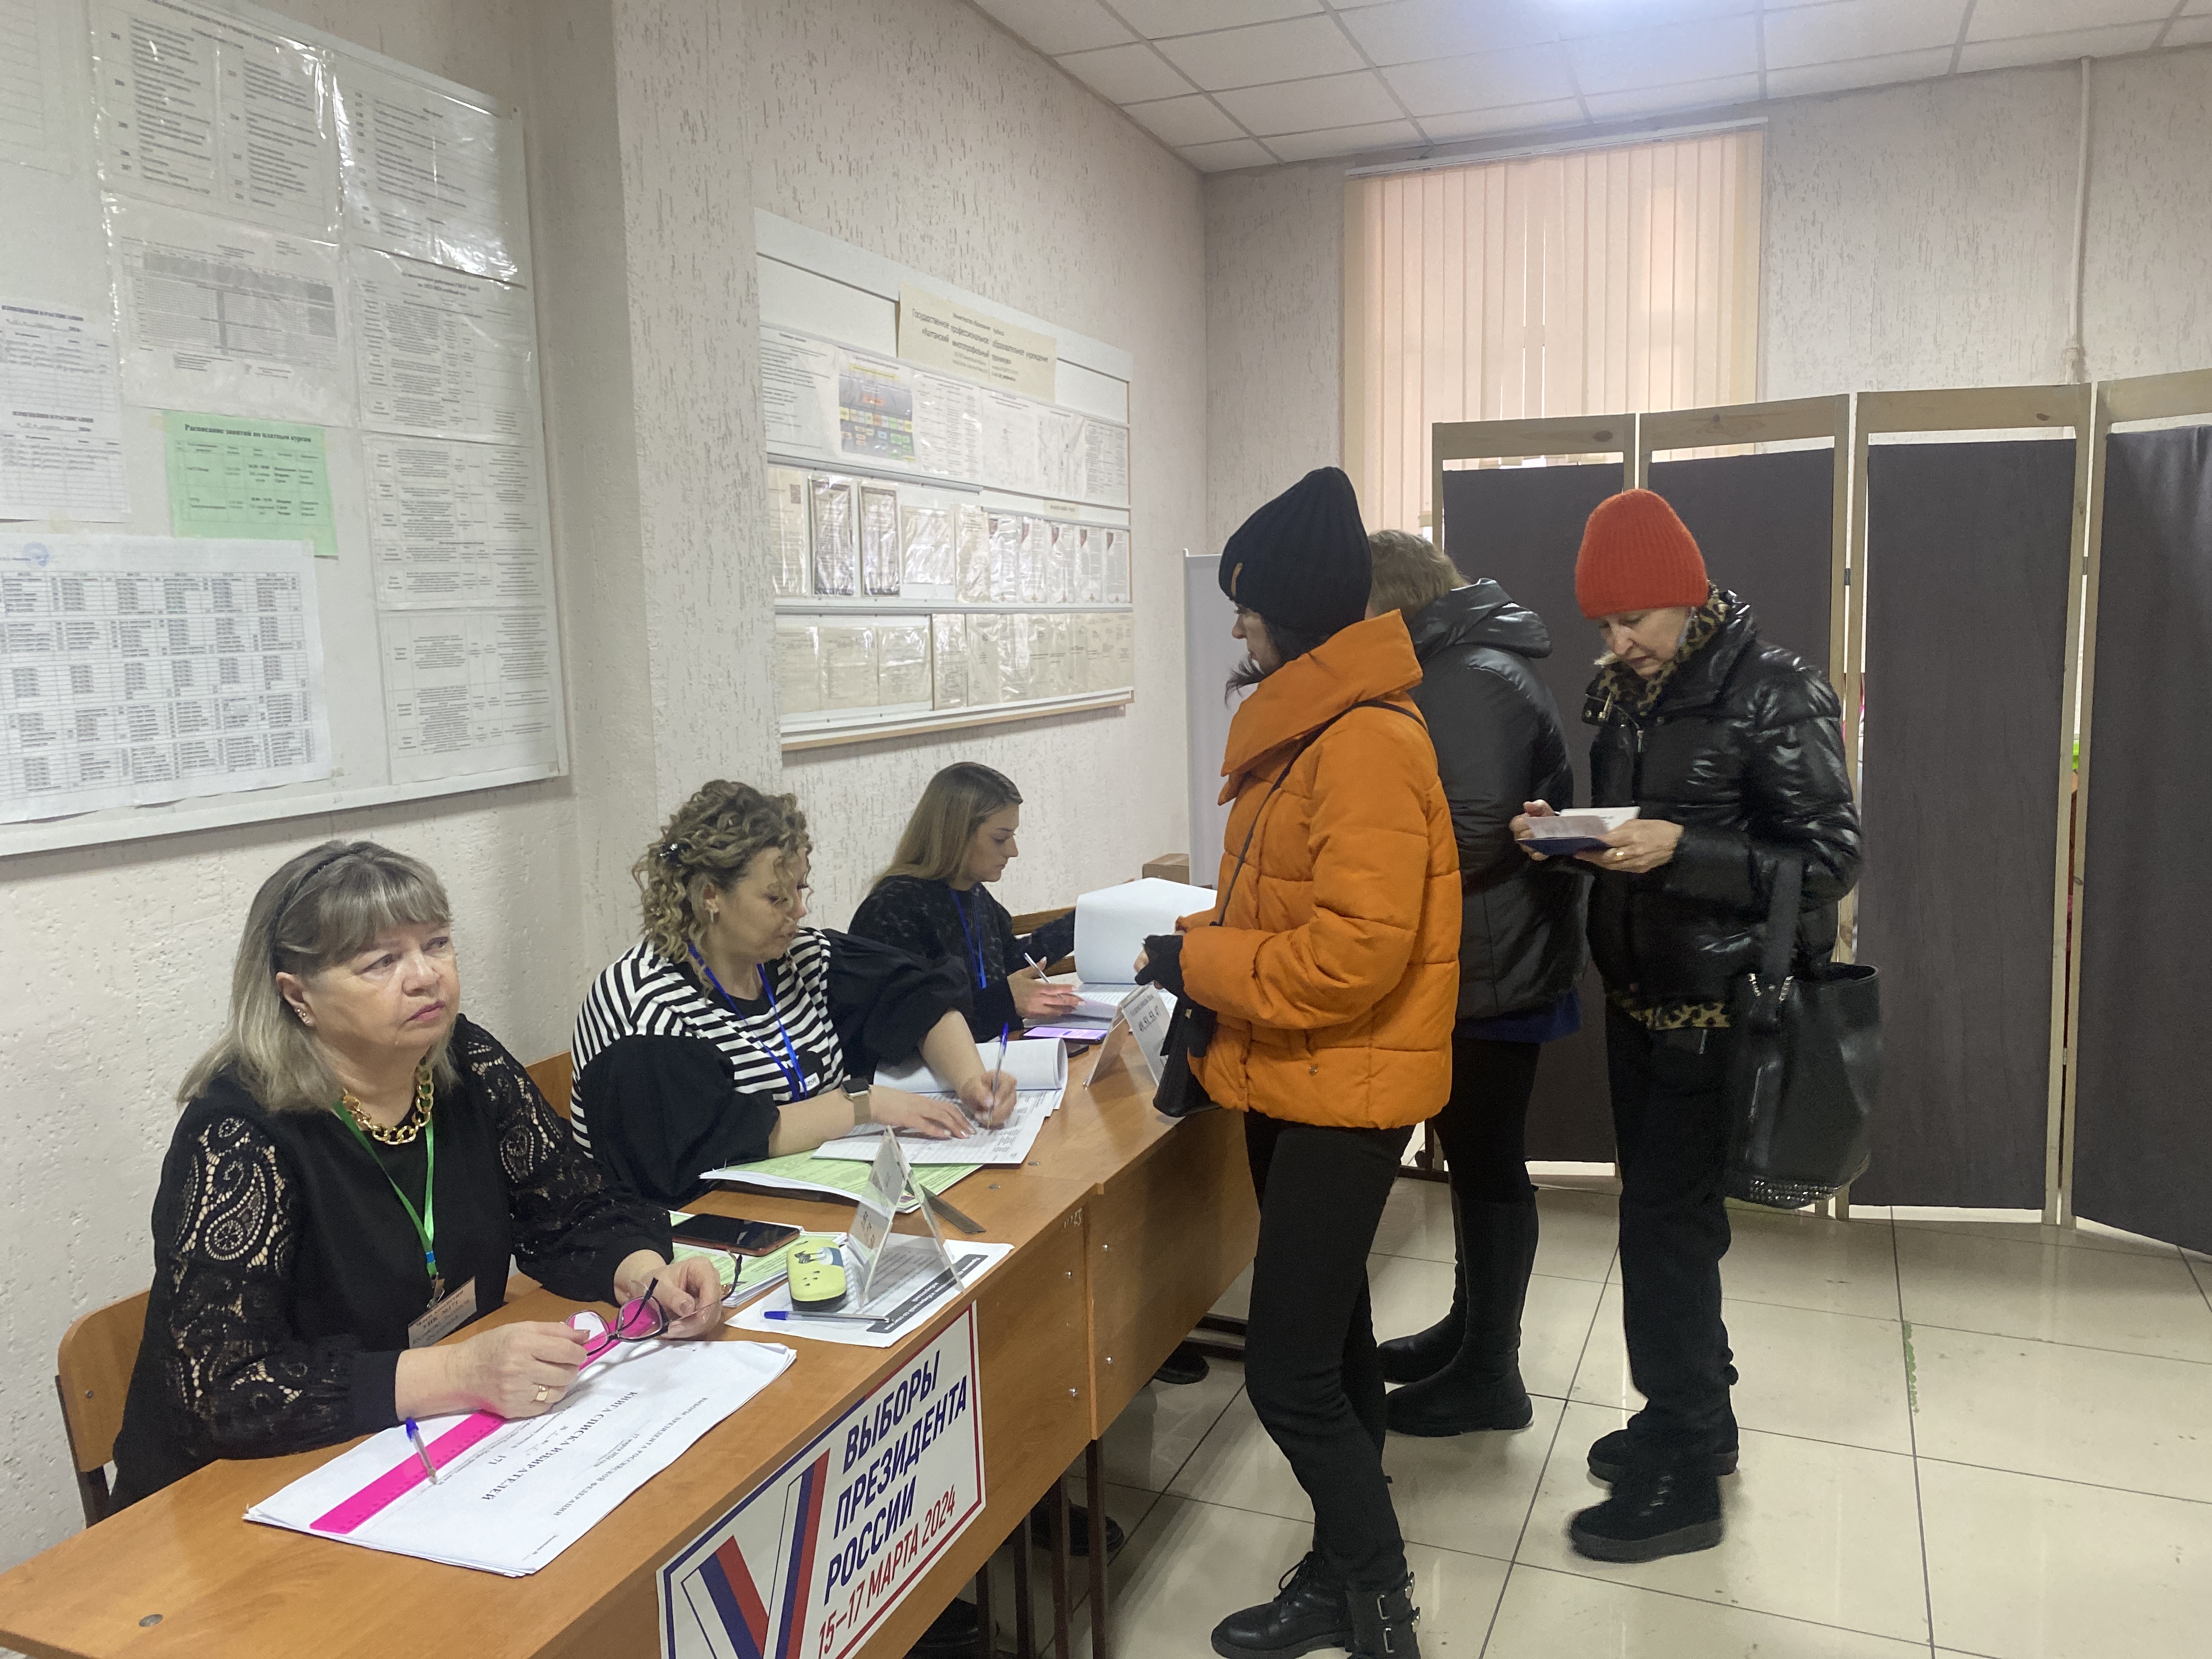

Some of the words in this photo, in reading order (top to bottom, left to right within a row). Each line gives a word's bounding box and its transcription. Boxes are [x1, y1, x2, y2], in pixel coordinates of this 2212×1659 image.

[184, 424, 224, 434] Расписание
[601, 1391, 637, 1413] КНИГА
[681, 1397, 709, 1415] ВЫБОРЫ
[842, 1351, 940, 1472] ВЫБОРЫ
[556, 1414, 607, 1446] СПИСКА
[612, 1438, 634, 1452] марта
[638, 1417, 684, 1448] ПРЕЗИДЕНТА
[487, 1455, 508, 1465] 171
[596, 1450, 644, 1482] РОССИЙСКОЙ
[603, 1451, 620, 1460] 2024
[833, 1376, 967, 1538] ПРЕЗИДЕНТА
[479, 1447, 563, 1500] ИЗБИРАТЕЛЕЙ
[552, 1482, 600, 1516] ФЕДЕРАЦИИ
[825, 1476, 916, 1604] РОССИИ
[867, 1528, 919, 1606] МАРТА
[921, 1485, 956, 1549] 2024
